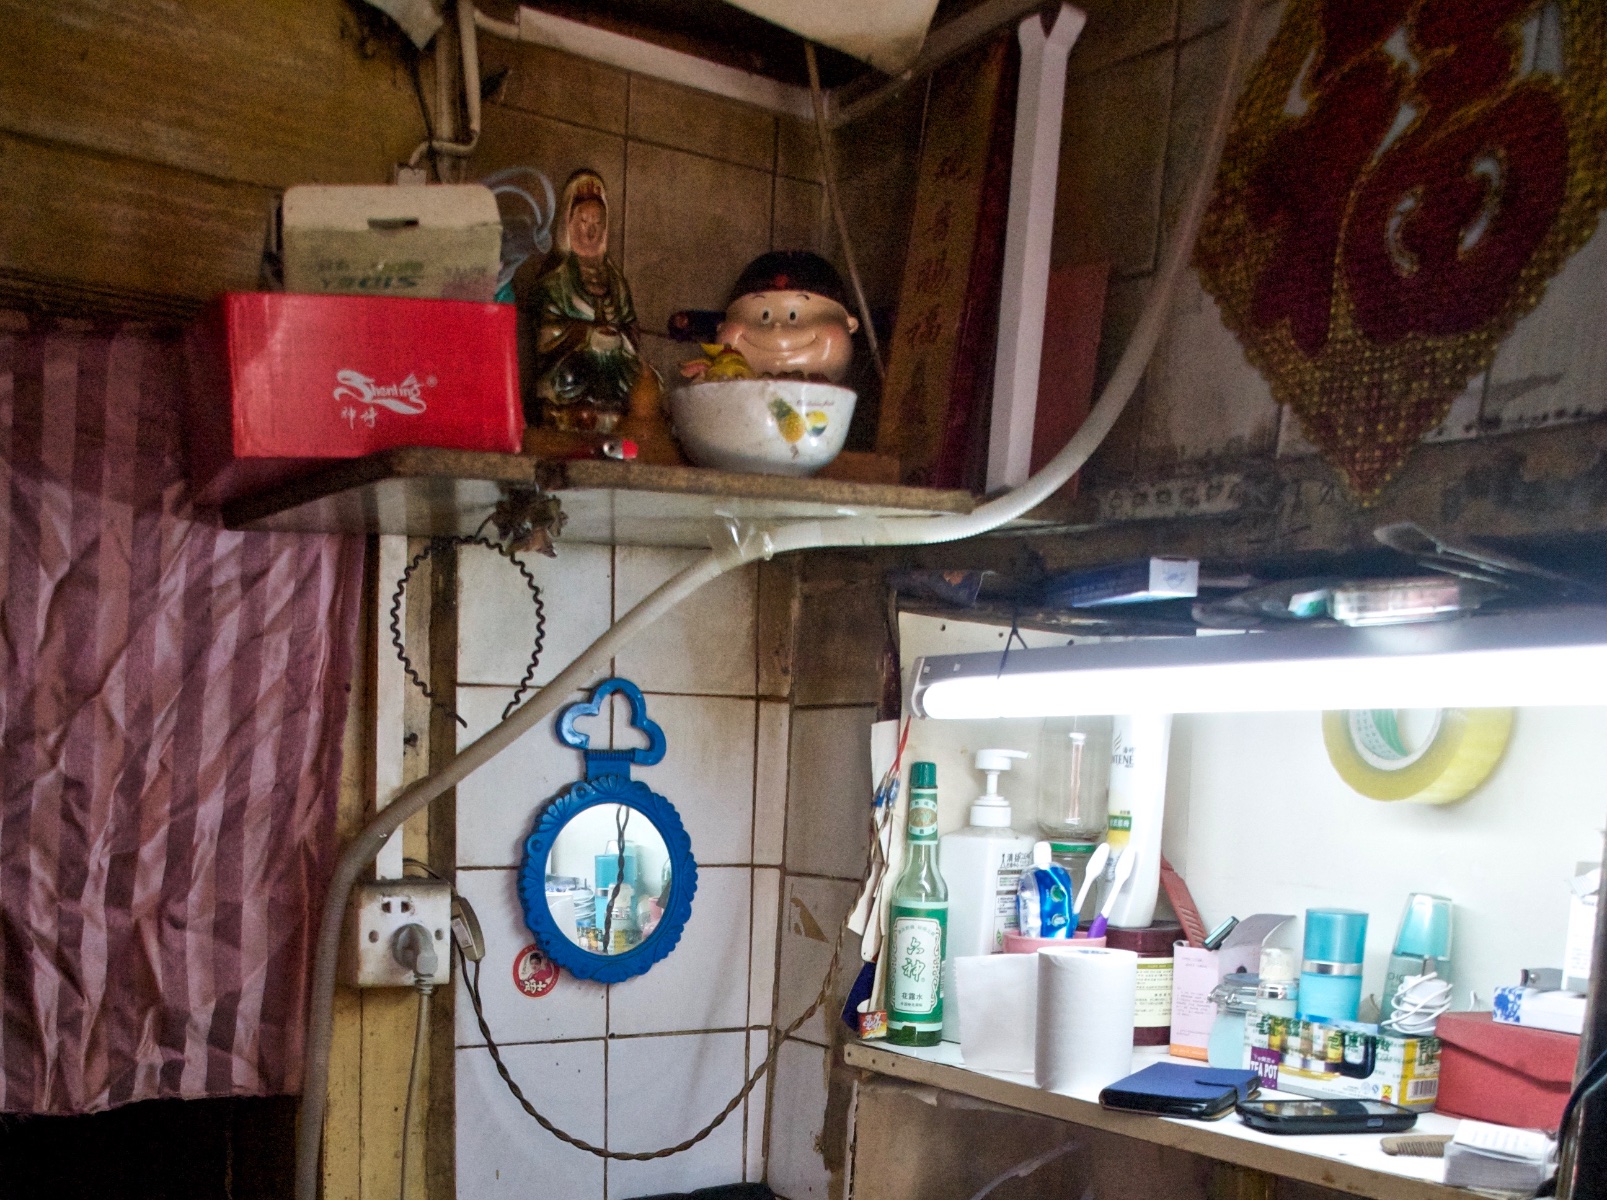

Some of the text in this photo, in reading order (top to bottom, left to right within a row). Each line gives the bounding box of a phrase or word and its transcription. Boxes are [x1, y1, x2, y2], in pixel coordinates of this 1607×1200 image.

[902, 936, 926, 982] 六神
[901, 992, 923, 1001] 花露水
[1263, 1063, 1278, 1080] POT
